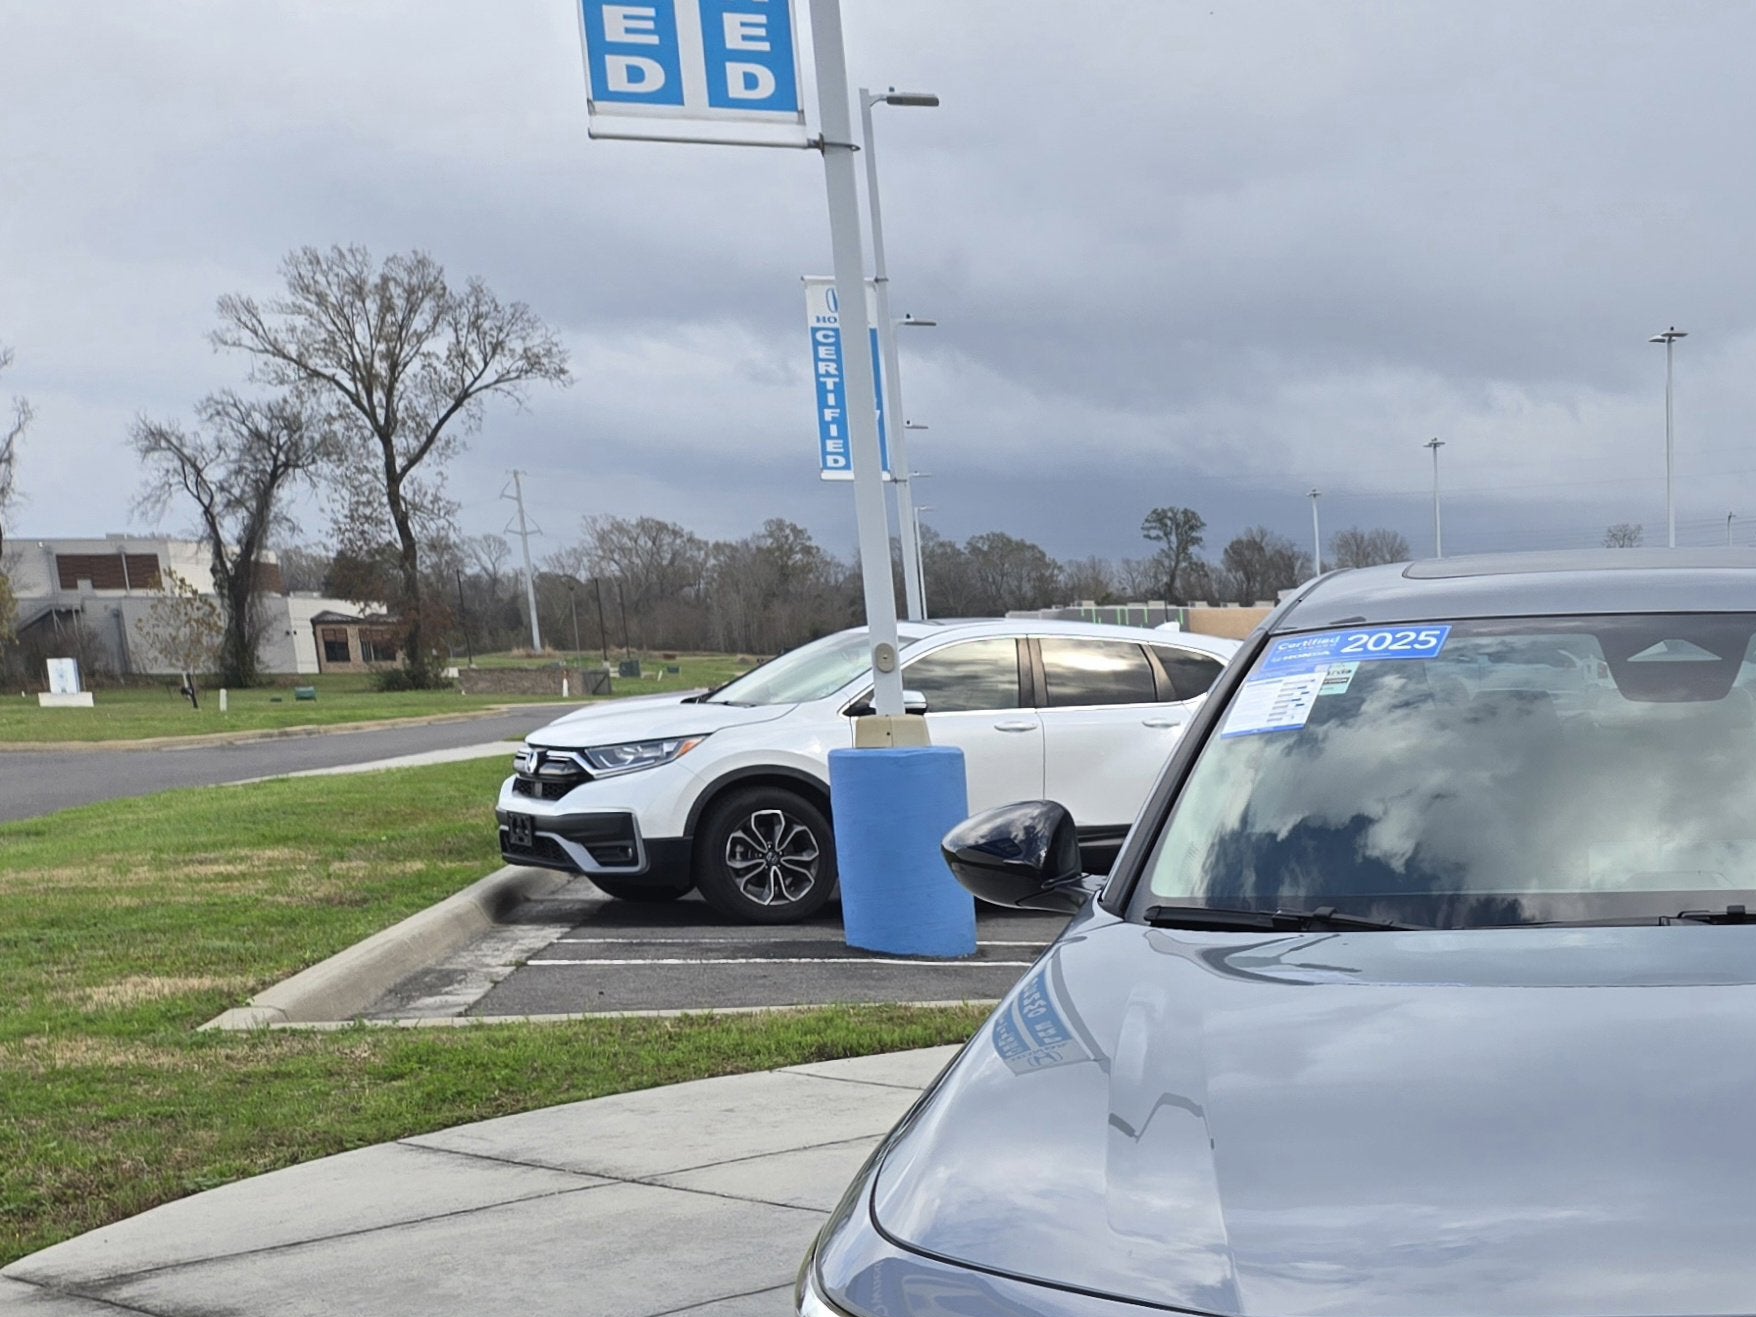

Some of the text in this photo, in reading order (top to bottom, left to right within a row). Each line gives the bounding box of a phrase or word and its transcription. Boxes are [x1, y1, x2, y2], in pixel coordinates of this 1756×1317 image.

[722, 0, 777, 100] ED
[814, 330, 847, 469] CERTIFIED
[1277, 635, 1342, 651] Certified
[1340, 630, 1441, 654] 2025
